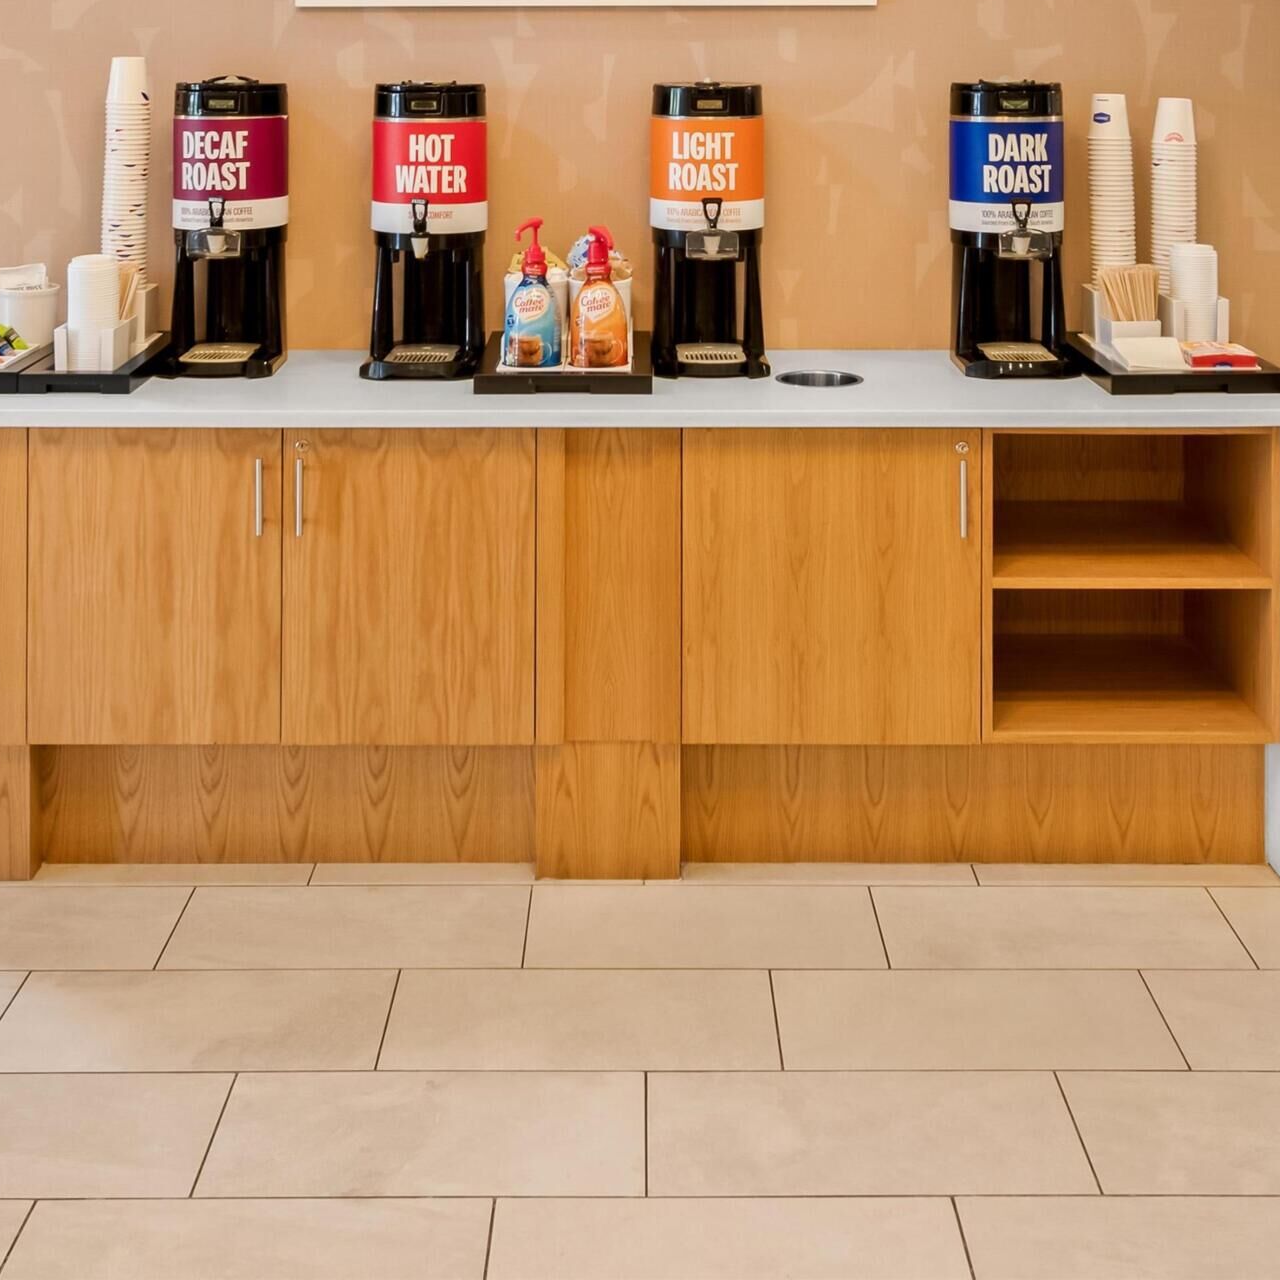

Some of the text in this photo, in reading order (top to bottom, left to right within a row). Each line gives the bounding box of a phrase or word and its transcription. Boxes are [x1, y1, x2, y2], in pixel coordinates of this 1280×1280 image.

[182, 130, 249, 160] DECAF
[409, 133, 455, 163] HOT
[672, 131, 735, 160] LIGHT
[988, 133, 1048, 162] DARK
[181, 161, 250, 191] ROAST
[395, 165, 467, 193] WATER
[668, 163, 739, 191] ROAST
[983, 164, 1052, 194] ROAST
[232, 206, 253, 216] COFFEE
[722, 207, 741, 217] COFFEE
[981, 209, 997, 219] 100%
[514, 296, 544, 308] Coffee
[519, 302, 545, 314] mate
[586, 301, 612, 313] mate
